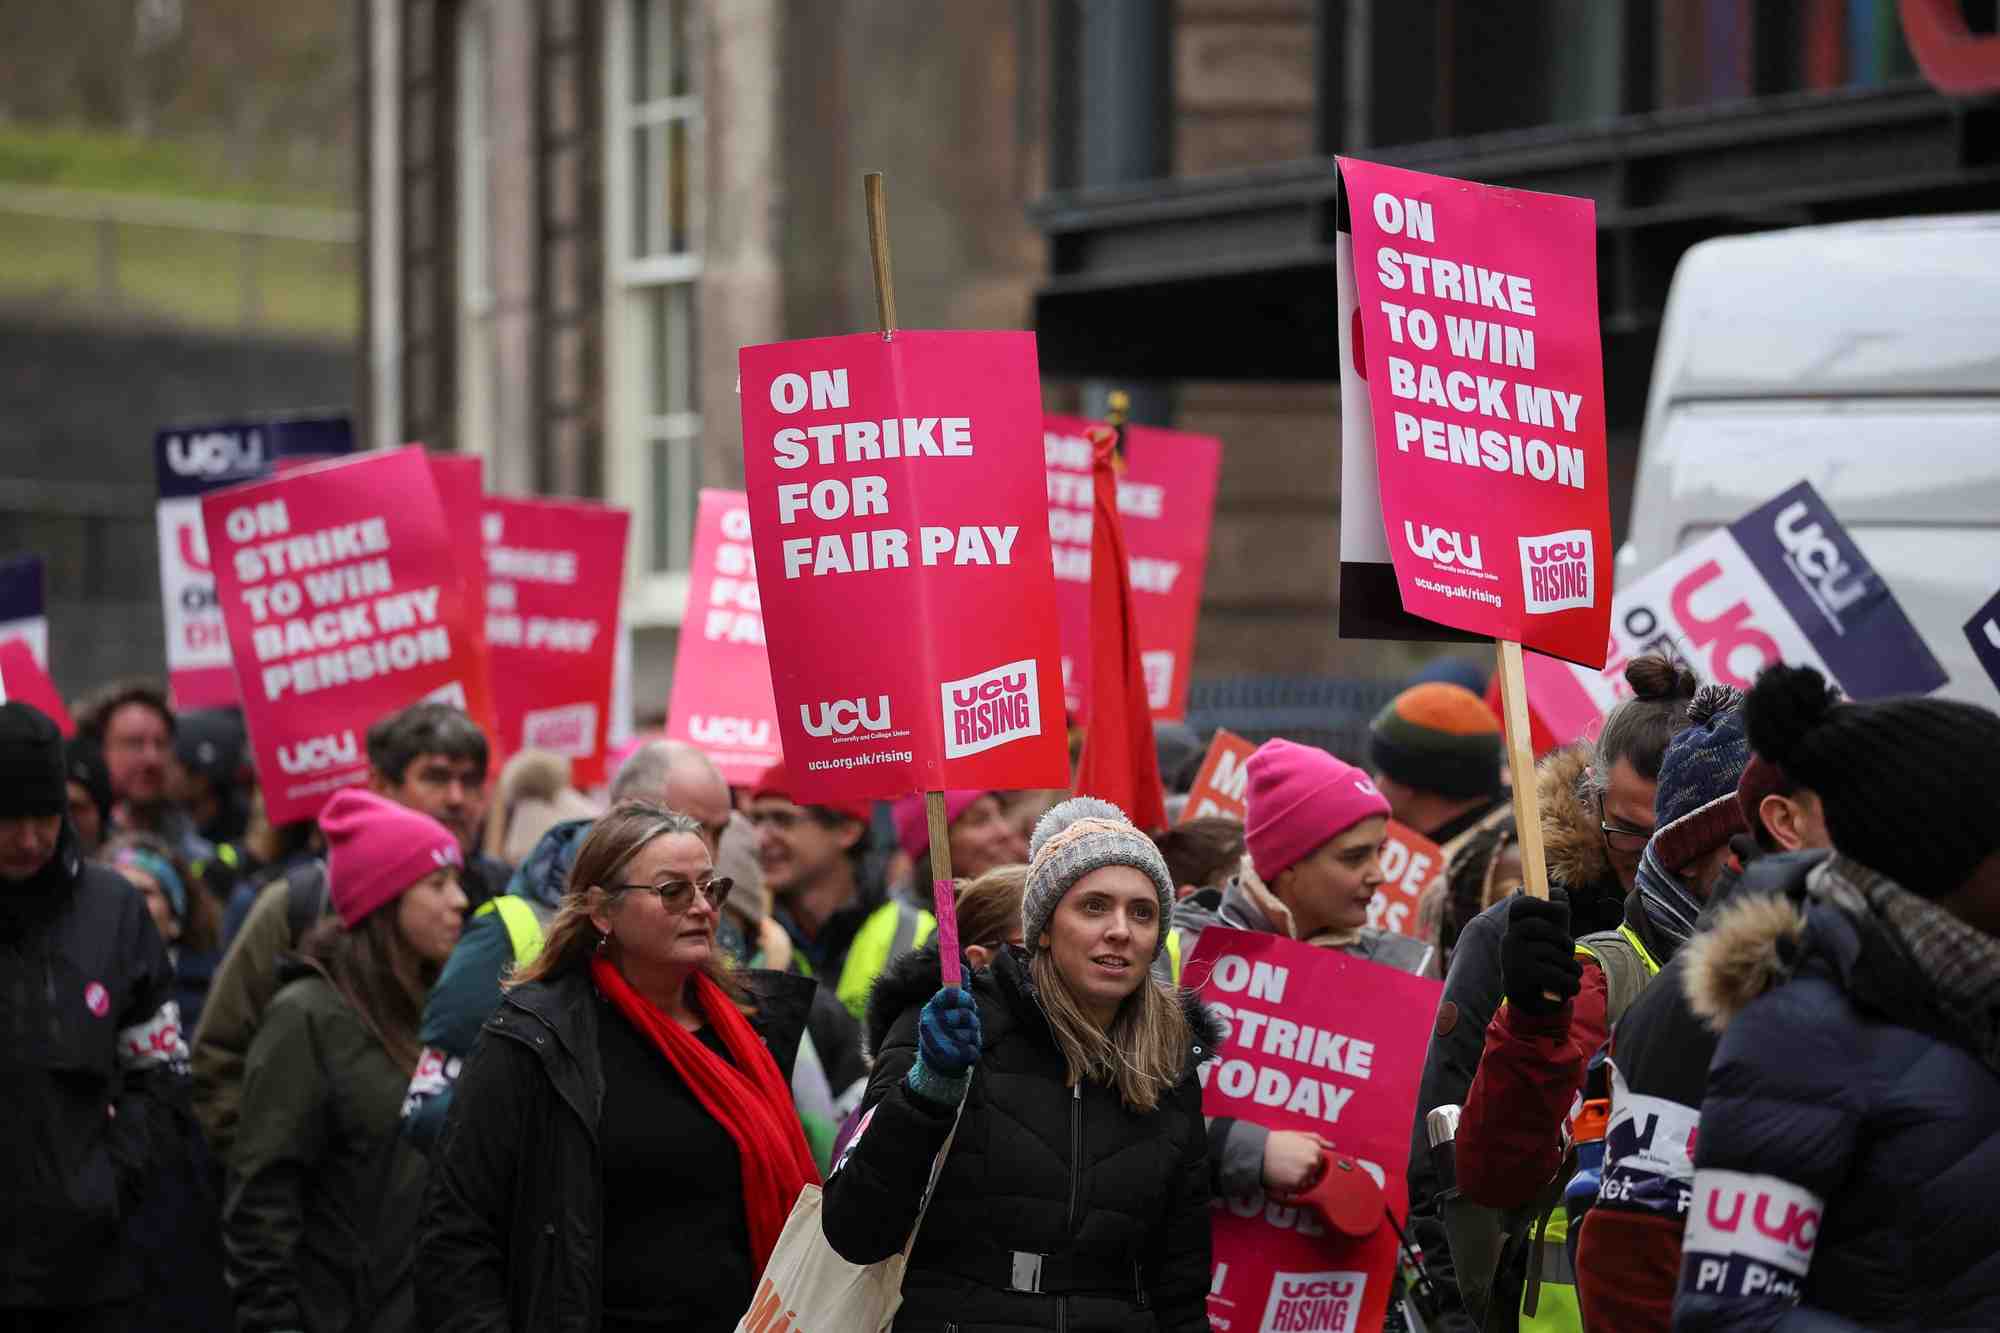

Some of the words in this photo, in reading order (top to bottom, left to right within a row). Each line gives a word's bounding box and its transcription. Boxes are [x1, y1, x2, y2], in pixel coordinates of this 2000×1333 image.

[1373, 193, 1434, 242] ON
[1376, 247, 1535, 316] STRIKE
[1380, 302, 1437, 349] TO
[1445, 315, 1535, 370] WIN
[770, 369, 849, 414] ON
[1388, 357, 1508, 420] BACK
[1513, 383, 1582, 432] MY
[773, 417, 973, 469] STRIKE
[1393, 411, 1584, 489] PENSION
[226, 499, 289, 542] ON
[778, 475, 888, 523] FOR
[234, 517, 390, 582] STRIKE
[782, 527, 909, 579] FAIR
[920, 526, 1018, 565] PAY
[1404, 520, 1482, 570] UCU
[1528, 541, 1585, 564] UCU
[1774, 500, 1866, 612] UCU
[243, 581, 301, 620] TO
[303, 559, 391, 607] WIN
[1414, 577, 1503, 609] ucu.org.uk/rising
[1531, 561, 1587, 602] RISING
[253, 603, 372, 661] BACK
[373, 586, 440, 632] MY
[1670, 559, 1783, 690] UC
[262, 624, 451, 702] PENSION
[953, 673, 1027, 707] UCU
[687, 714, 770, 746] UCU
[800, 695, 891, 737] UCU
[954, 693, 1029, 745] RISING
[277, 729, 358, 774] UCU
[808, 750, 913, 770] ucu.org.uk/rising
[1213, 955, 1289, 1003] ON
[1208, 1002, 1375, 1079] STRIKE
[1197, 1056, 1354, 1123] TODAY
[1281, 1281, 1355, 1297] UCU
[1271, 1300, 1349, 1331] RISING
